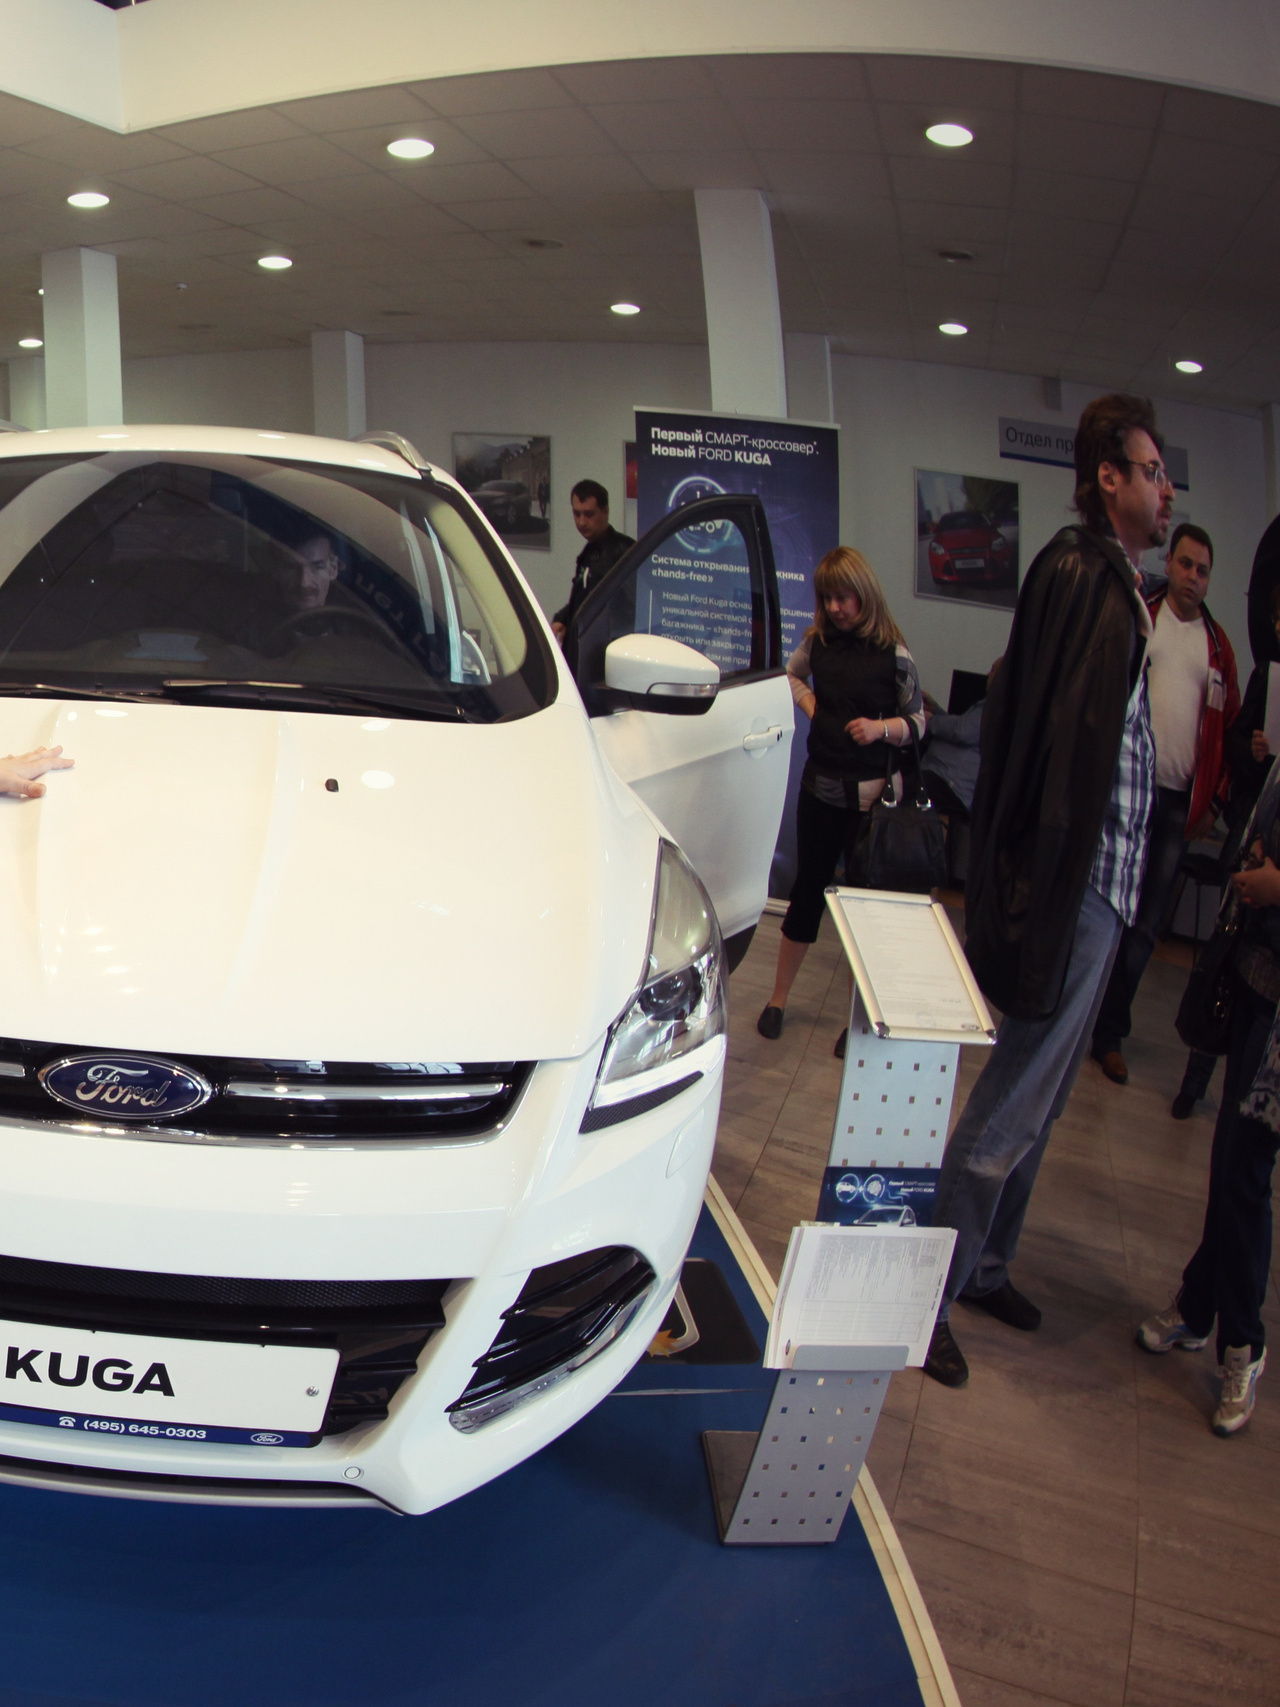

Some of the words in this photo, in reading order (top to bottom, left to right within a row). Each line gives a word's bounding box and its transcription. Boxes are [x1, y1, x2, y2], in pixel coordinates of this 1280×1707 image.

[651, 427, 703, 442] Первый
[1006, 426, 1051, 449] Отдел
[651, 443, 696, 458] Новый
[698, 447, 732, 461] FORD
[734, 450, 771, 466] KUGA
[651, 554, 692, 567] Система
[662, 591, 689, 602] Новый
[690, 594, 708, 605] Ford
[709, 597, 728, 608] Kuga
[662, 606, 709, 618] уникальной
[710, 612, 748, 623] системой
[76, 1064, 171, 1107] Ford
[5, 1345, 175, 1397] KUGA
[83, 1419, 125, 1433] (495)
[128, 1424, 207, 1439] 645-0303
